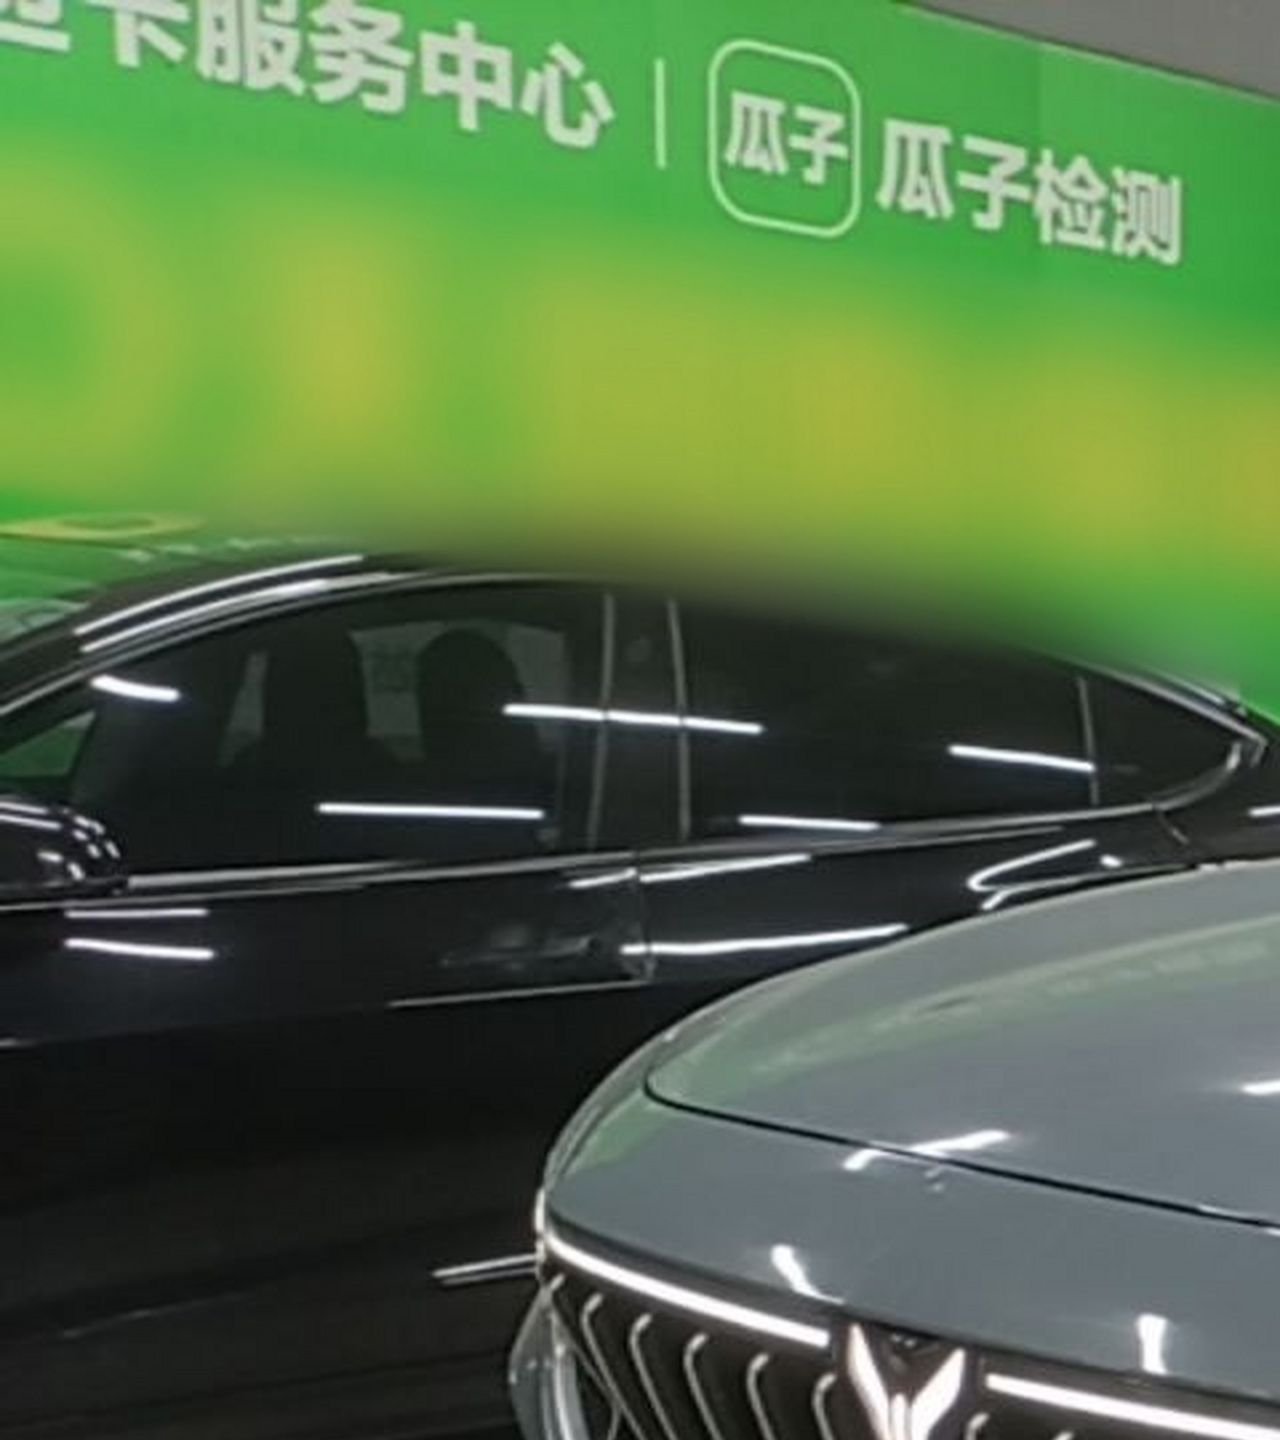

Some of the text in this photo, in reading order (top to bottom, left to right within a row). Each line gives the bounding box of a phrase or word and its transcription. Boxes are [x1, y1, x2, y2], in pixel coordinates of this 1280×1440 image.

[724, 91, 849, 185] 瓜子
[875, 118, 1182, 265] 瓜子检测
